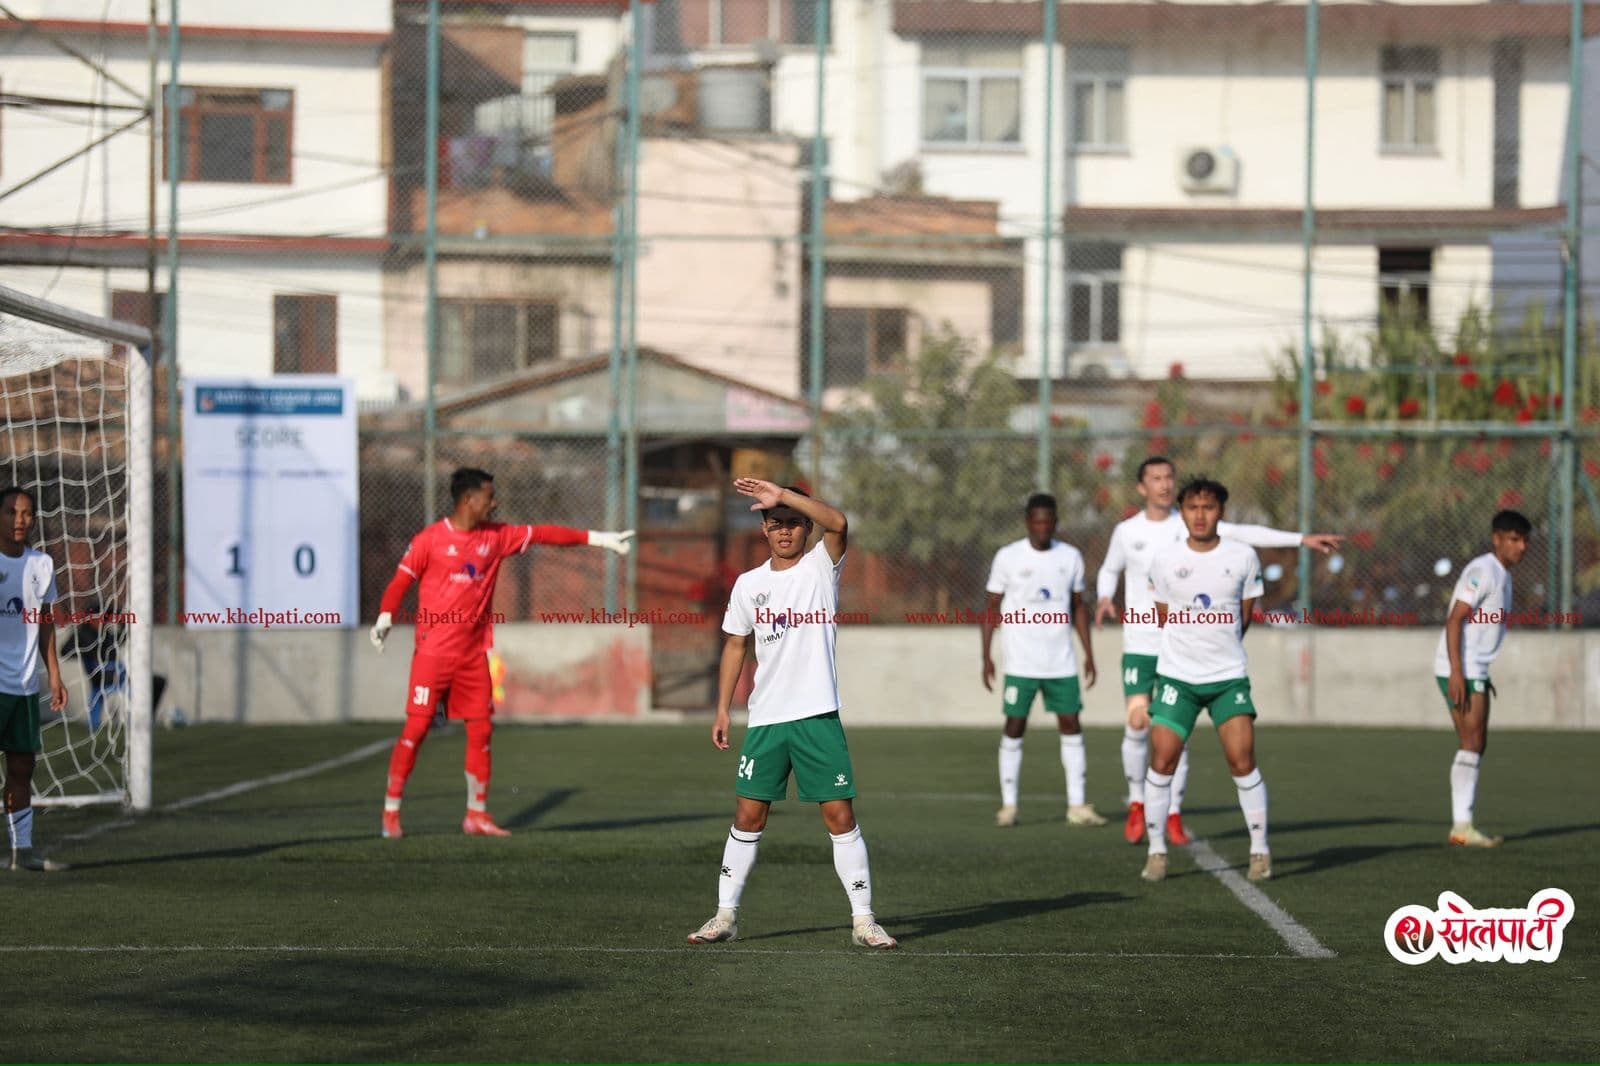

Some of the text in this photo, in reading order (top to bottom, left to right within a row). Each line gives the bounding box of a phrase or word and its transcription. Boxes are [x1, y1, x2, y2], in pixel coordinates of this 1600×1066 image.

[236, 424, 304, 450] SCORE
[226, 543, 246, 577] 1
[294, 543, 316, 577] 0
[413, 685, 430, 706] 31
[738, 755, 755, 780] 24
